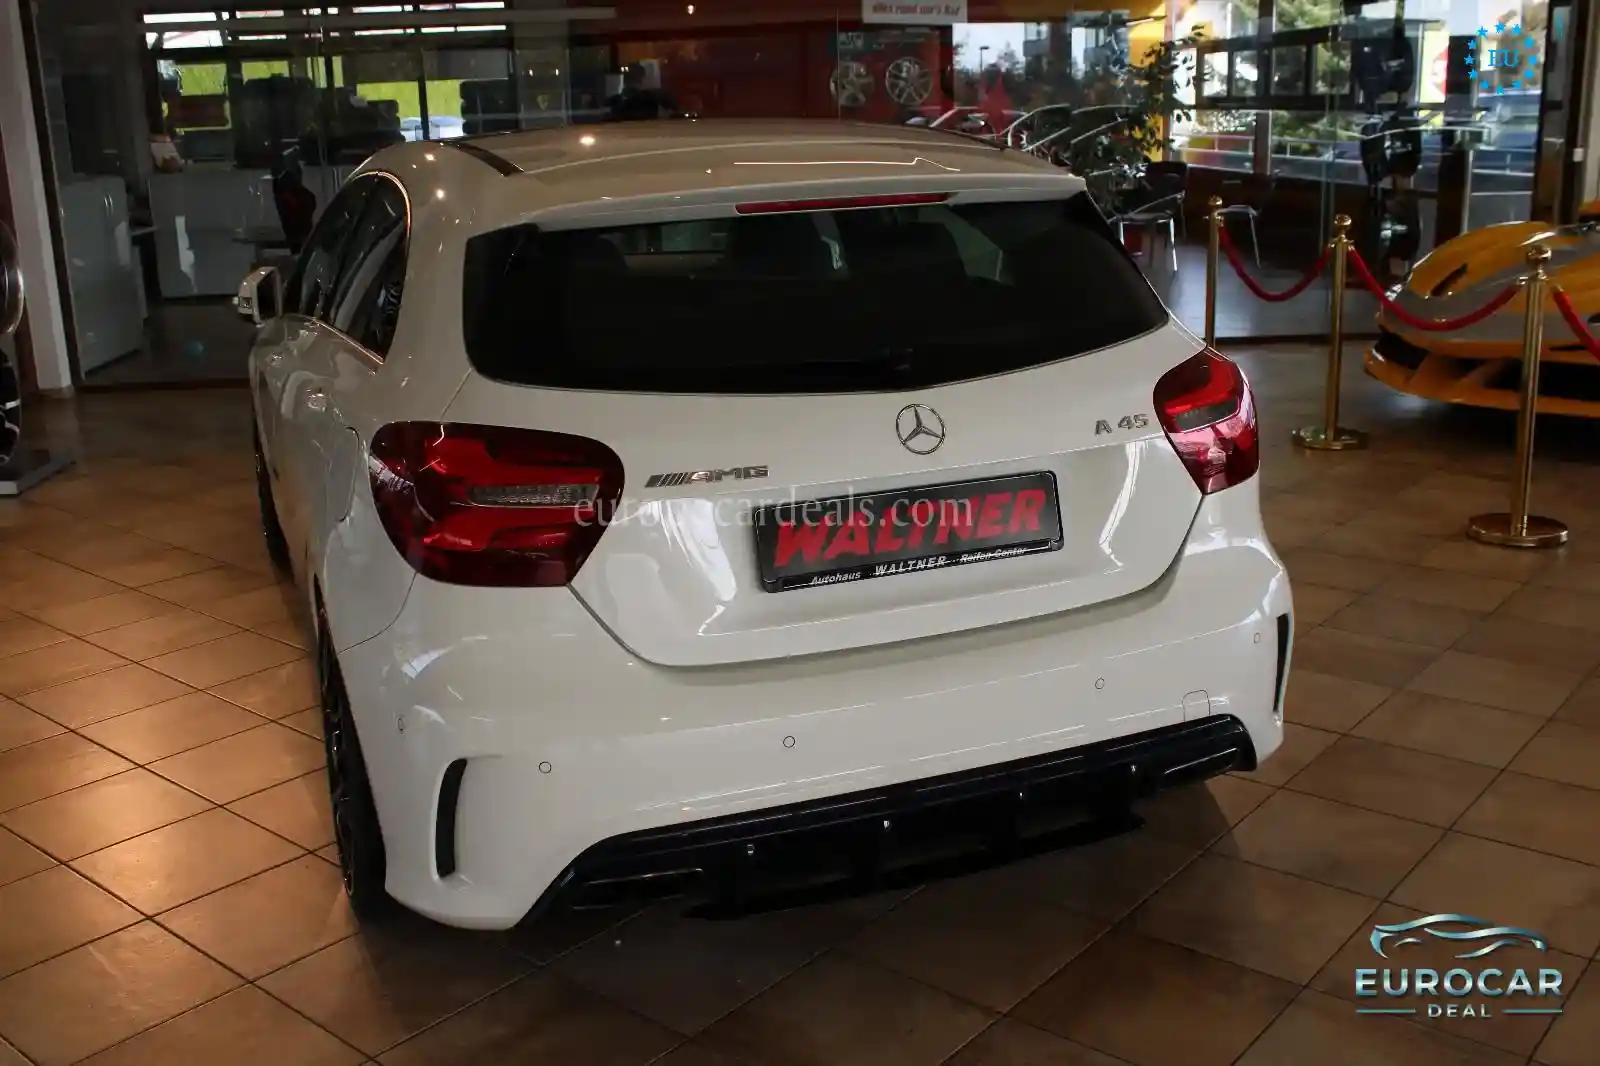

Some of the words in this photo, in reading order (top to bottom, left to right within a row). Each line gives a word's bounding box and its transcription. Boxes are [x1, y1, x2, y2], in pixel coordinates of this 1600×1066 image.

[1094, 419, 1113, 435] A
[1117, 413, 1149, 430] 45
[687, 465, 769, 485] AMG
[774, 488, 1048, 568] WALTNER
[811, 571, 862, 585] Autohaus
[874, 555, 947, 576] WALTNER
